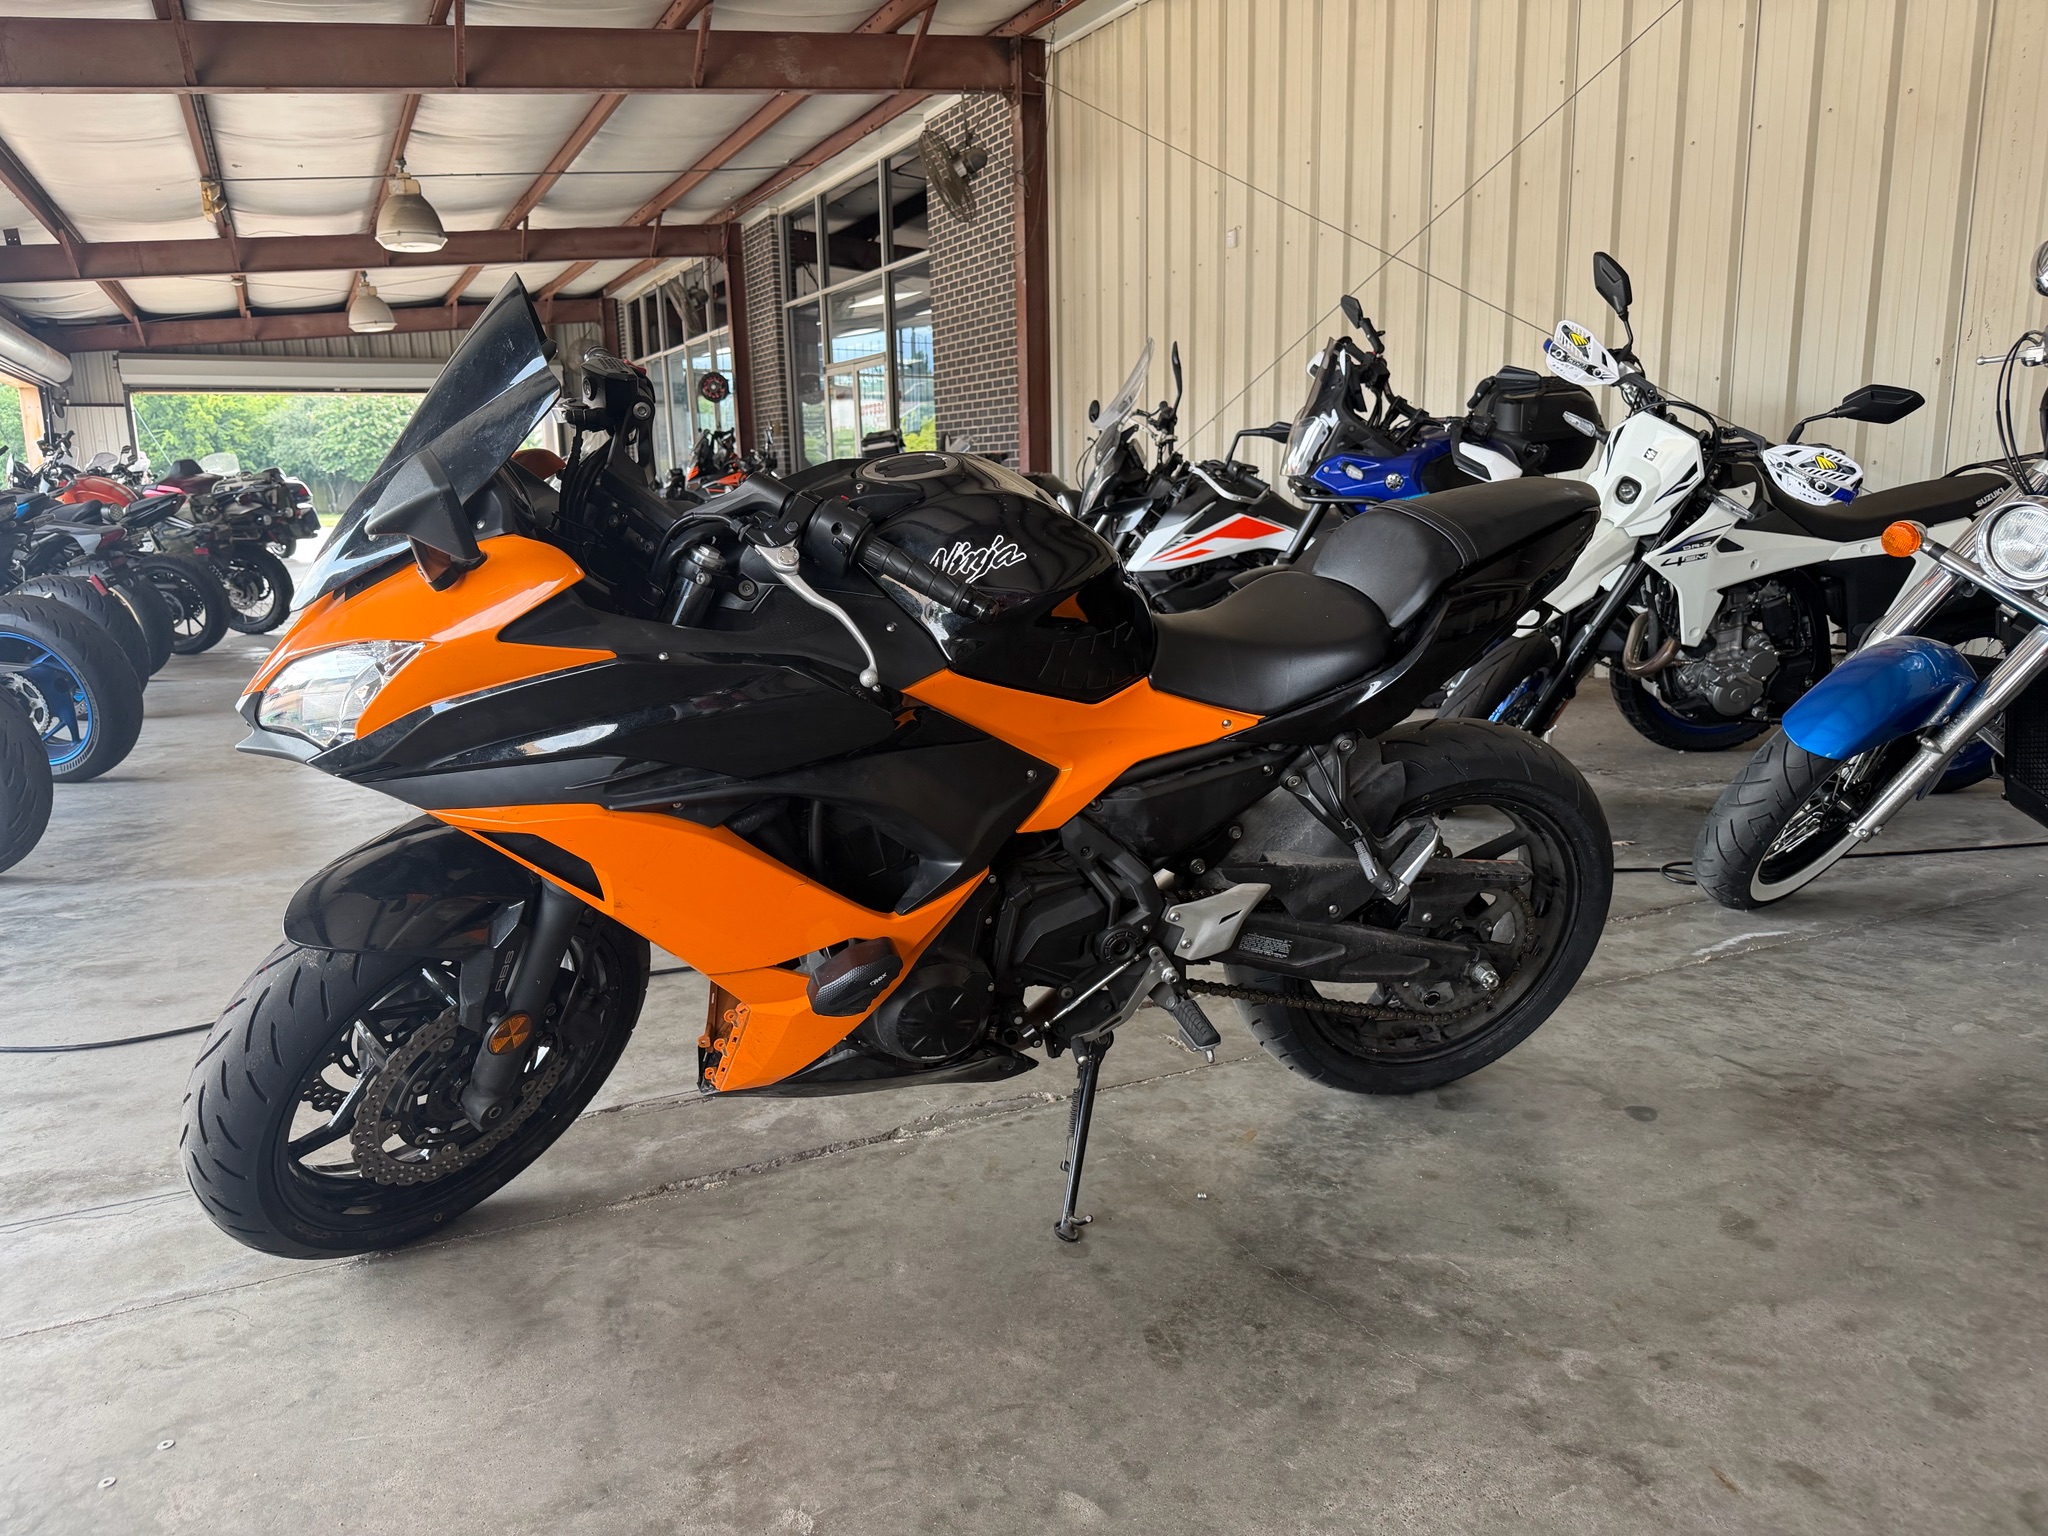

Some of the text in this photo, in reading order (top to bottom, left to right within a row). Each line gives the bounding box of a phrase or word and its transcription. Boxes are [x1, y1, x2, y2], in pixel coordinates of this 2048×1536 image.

[1975, 487, 2005, 508] SUZUKI
[929, 534, 1027, 584] Ninja
[495, 951, 514, 991] ABS
